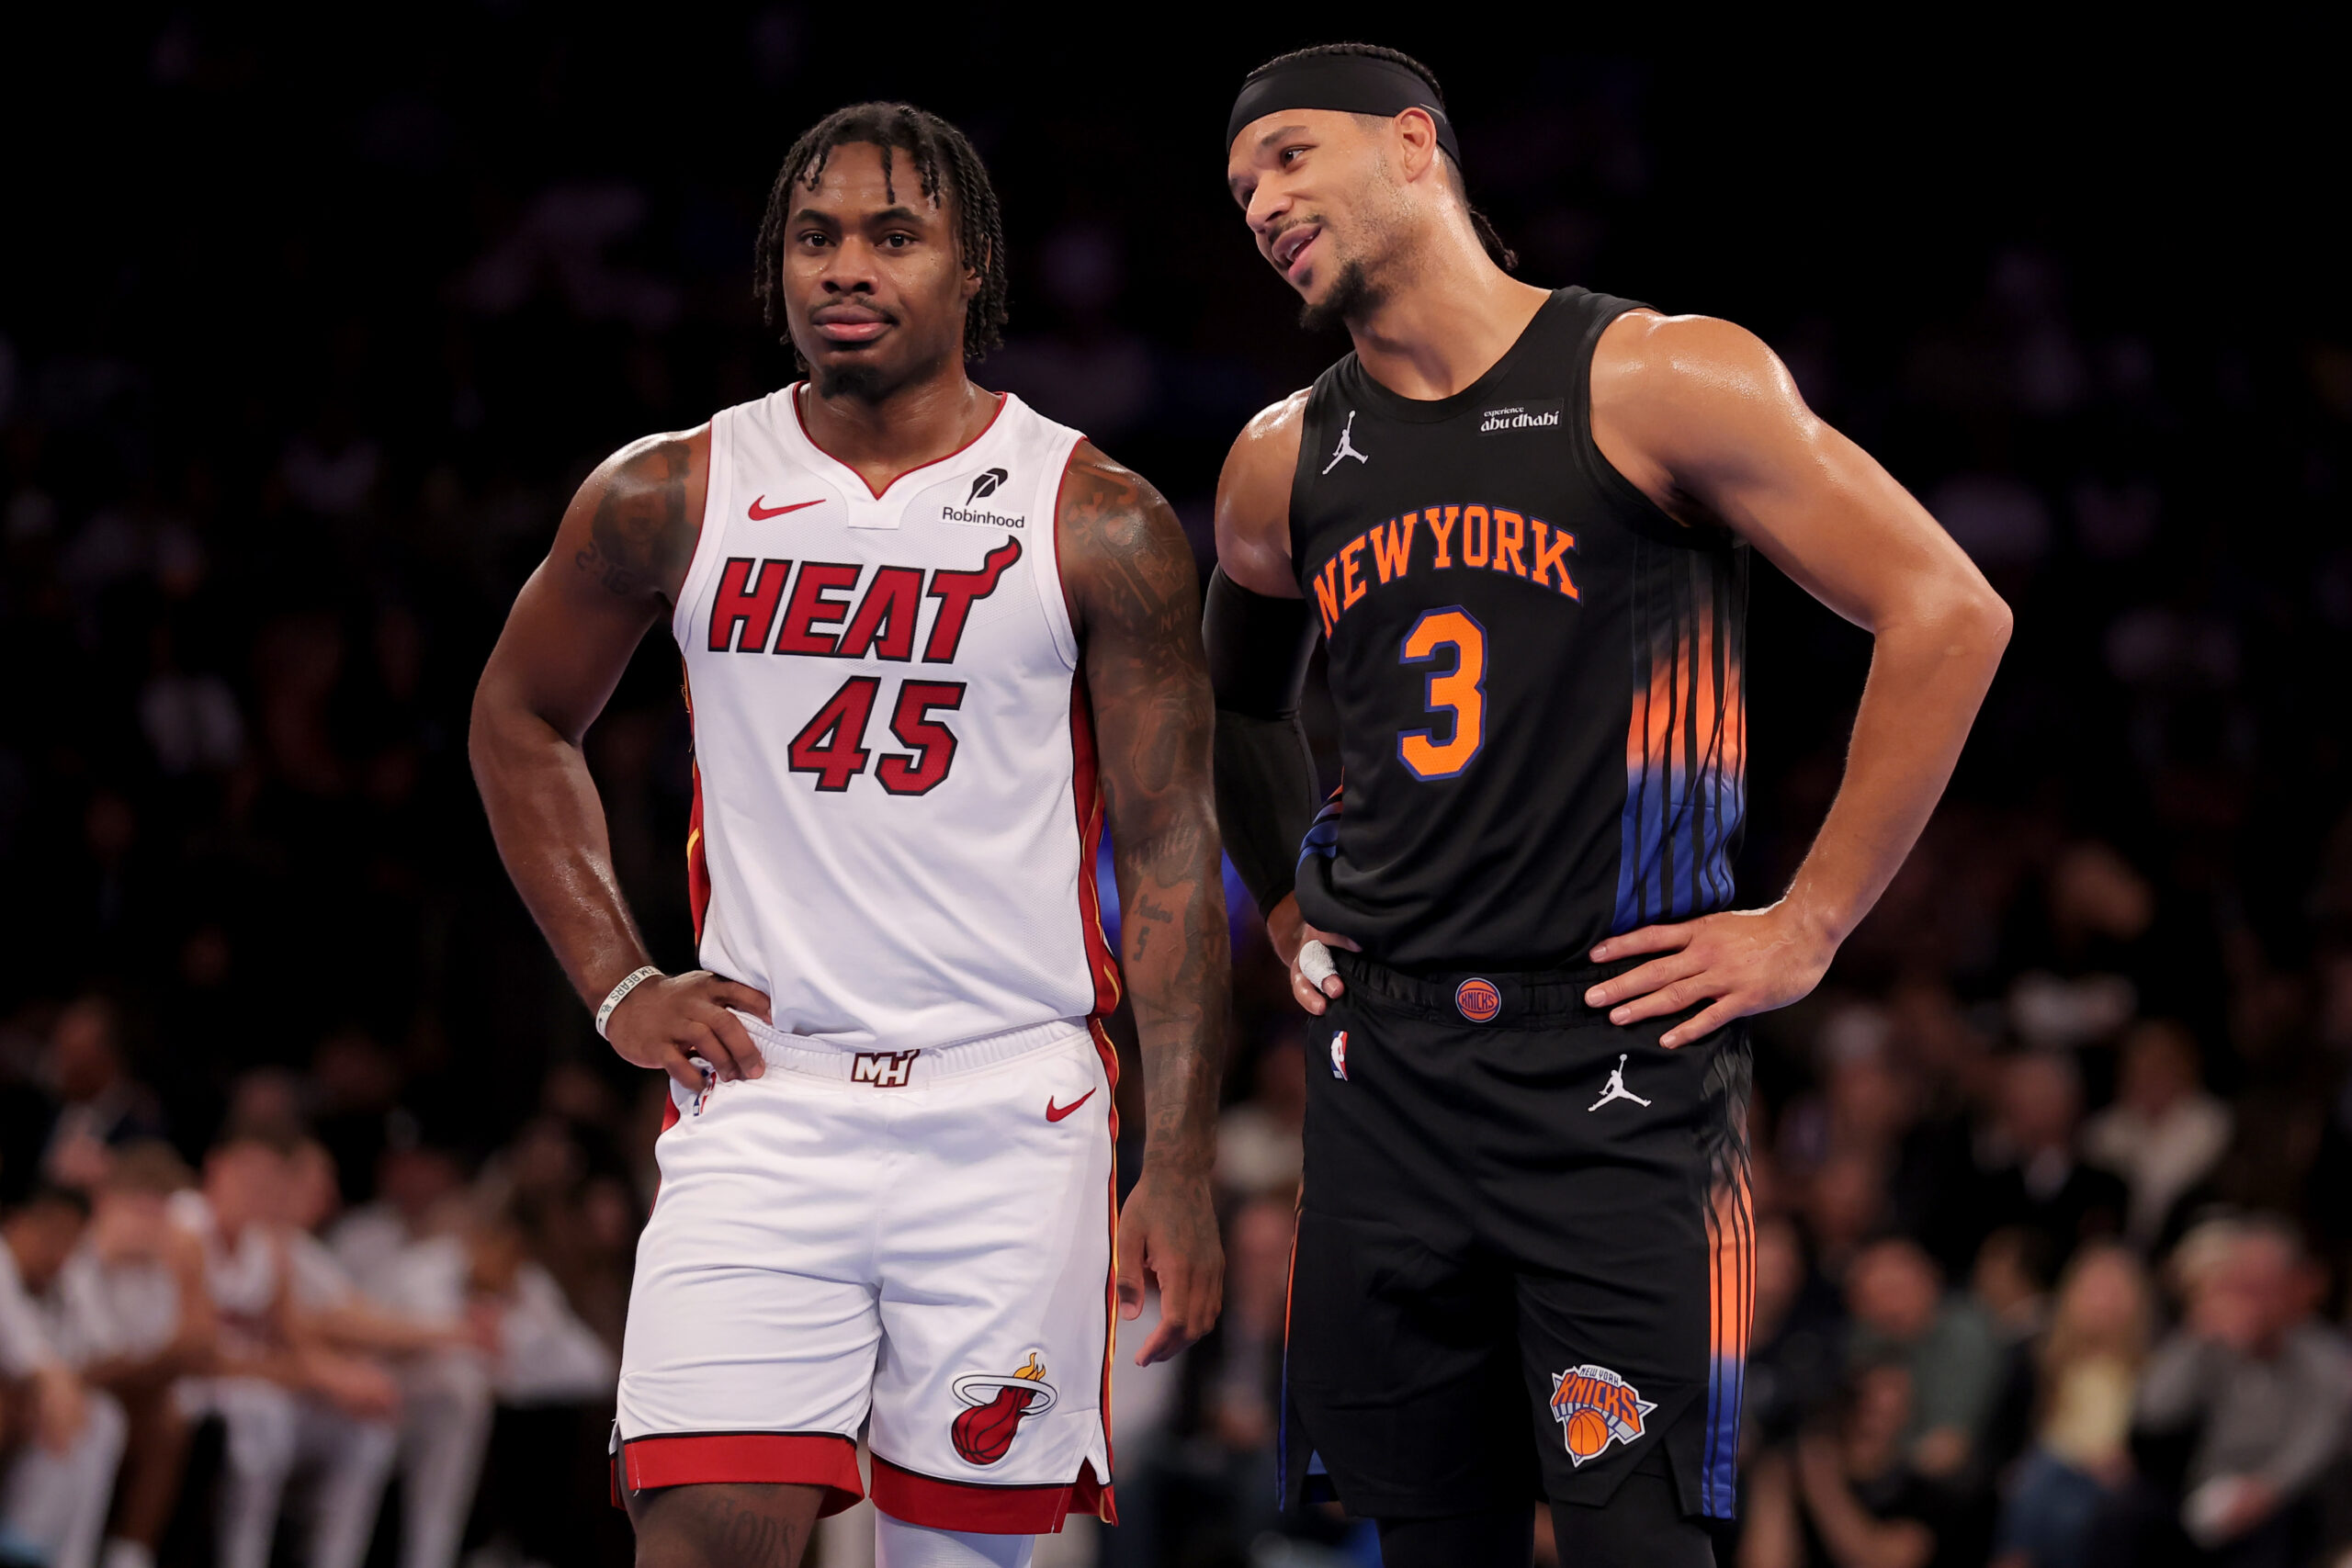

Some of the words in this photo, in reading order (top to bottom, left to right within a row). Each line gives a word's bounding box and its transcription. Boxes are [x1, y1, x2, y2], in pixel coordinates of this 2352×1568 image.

[1480, 417, 1510, 432] abu
[1512, 411, 1559, 428] dhabi
[1484, 407, 1524, 418] experience
[942, 506, 1025, 529] Robinhood
[1313, 507, 1419, 640] NEW
[1423, 502, 1583, 605] YORK
[707, 535, 1023, 664] HEAT
[1396, 604, 1487, 782] 3
[787, 676, 967, 796] 45
[610, 974, 641, 1001] BEARS
[1461, 991, 1495, 1010] KNICKS
[851, 1049, 921, 1088] MH
[1579, 1367, 1598, 1377] NEW
[1598, 1369, 1620, 1386] YORK
[1552, 1372, 1641, 1433] KNICKS
